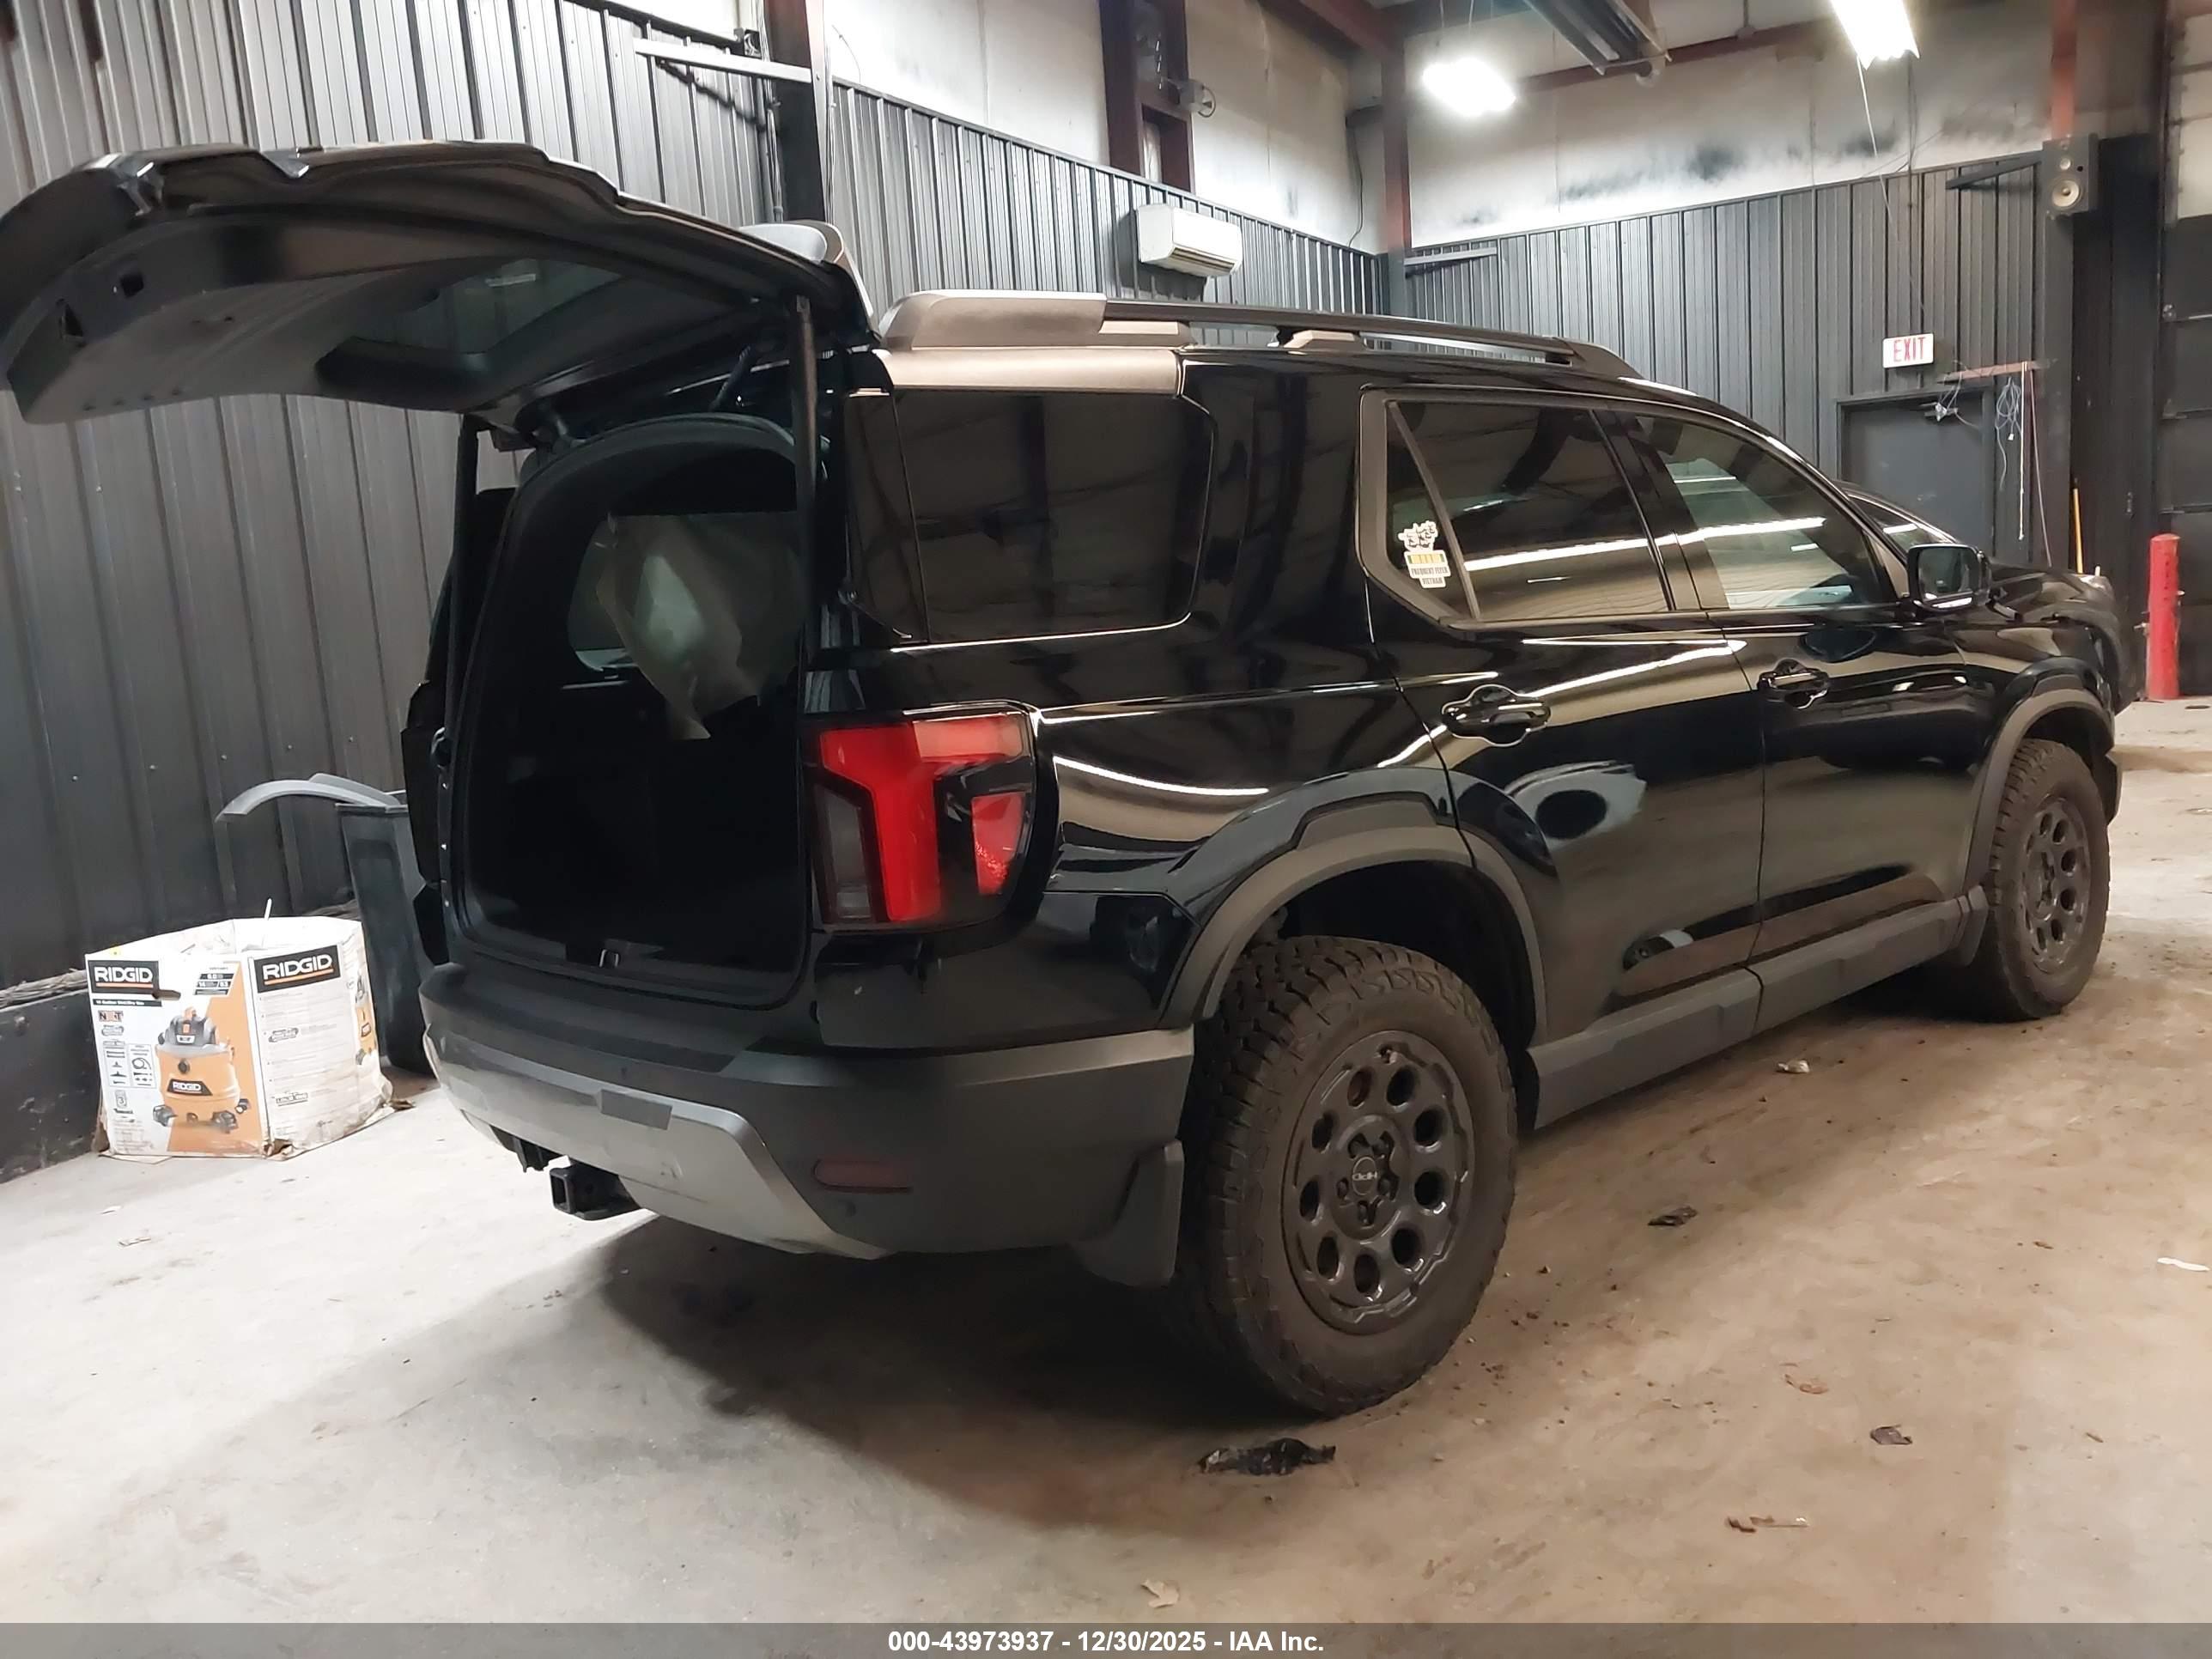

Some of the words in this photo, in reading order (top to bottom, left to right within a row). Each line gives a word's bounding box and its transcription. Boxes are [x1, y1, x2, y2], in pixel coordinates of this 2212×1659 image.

[1893, 336, 1926, 362] EXIT
[94, 966, 154, 983] RIDGID
[262, 953, 333, 981] RIDGID
